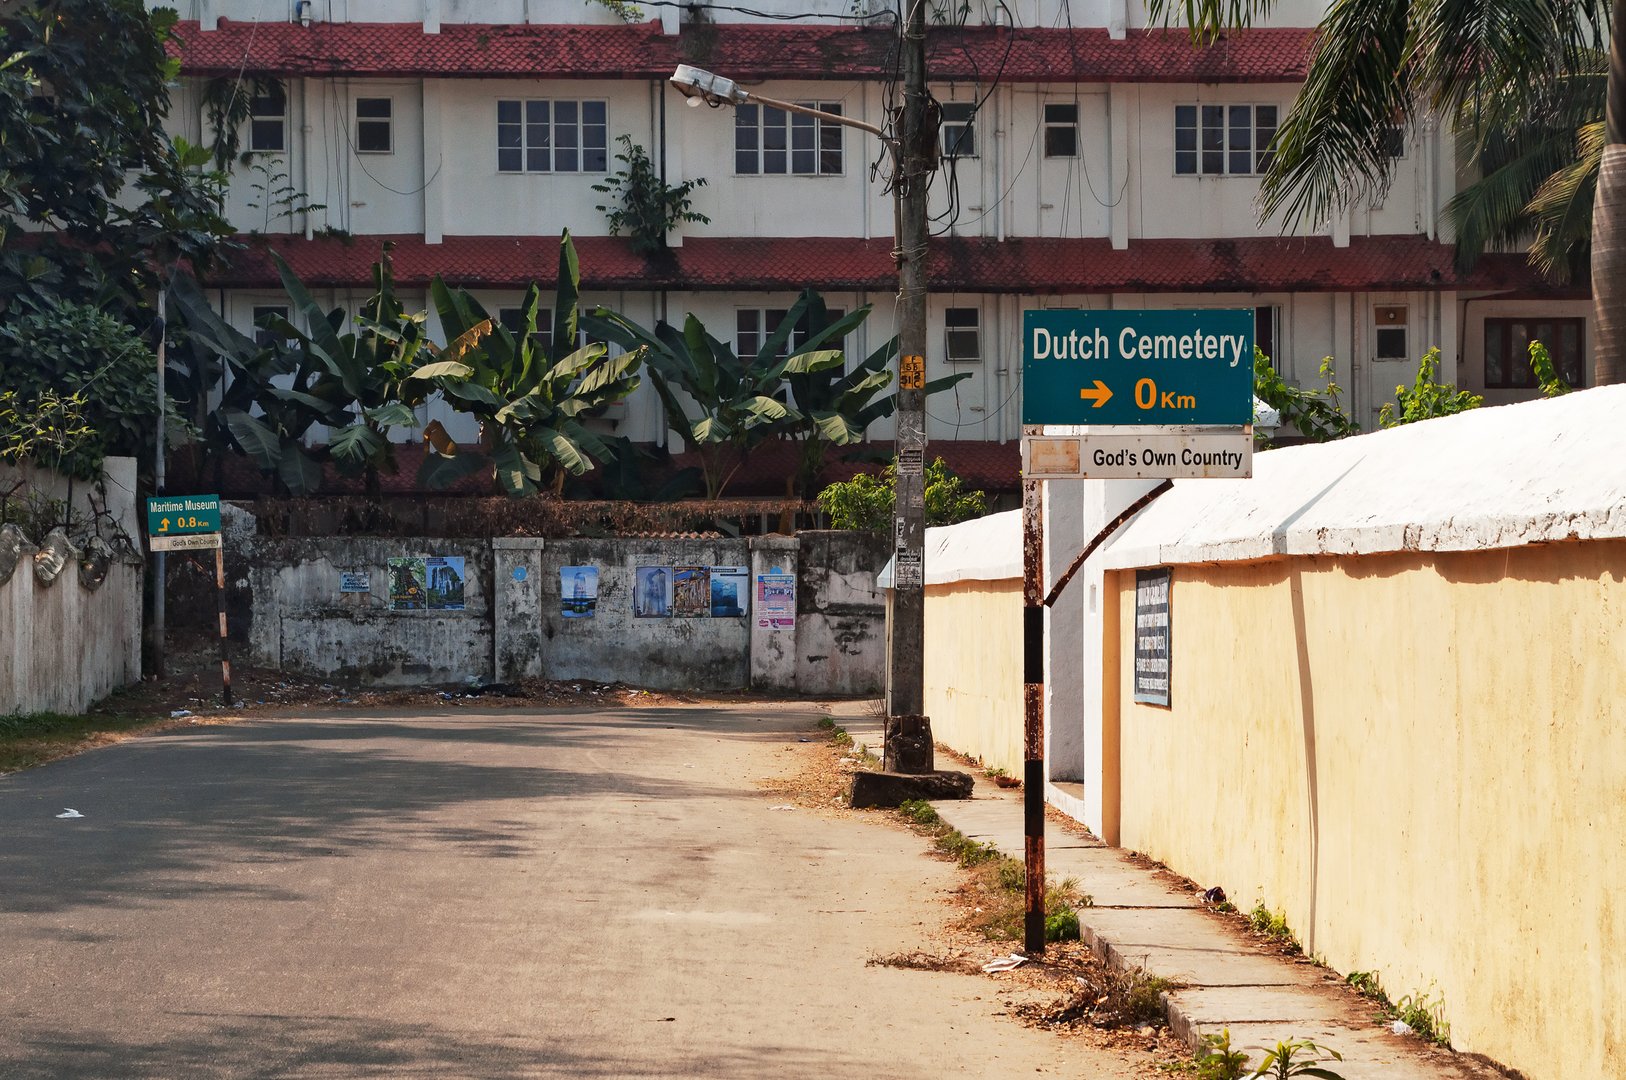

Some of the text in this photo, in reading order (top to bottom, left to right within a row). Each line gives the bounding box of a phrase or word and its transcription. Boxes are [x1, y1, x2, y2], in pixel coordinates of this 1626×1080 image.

[1033, 327, 1245, 368] Dutch Cemetery
[1135, 377, 1196, 410] 0 Km
[1093, 448, 1243, 470] God's Own Country
[150, 500, 217, 513] Maritime Museum
[177, 516, 197, 528] 0.8
[172, 539, 187, 547] God's
[199, 538, 219, 546] Country
